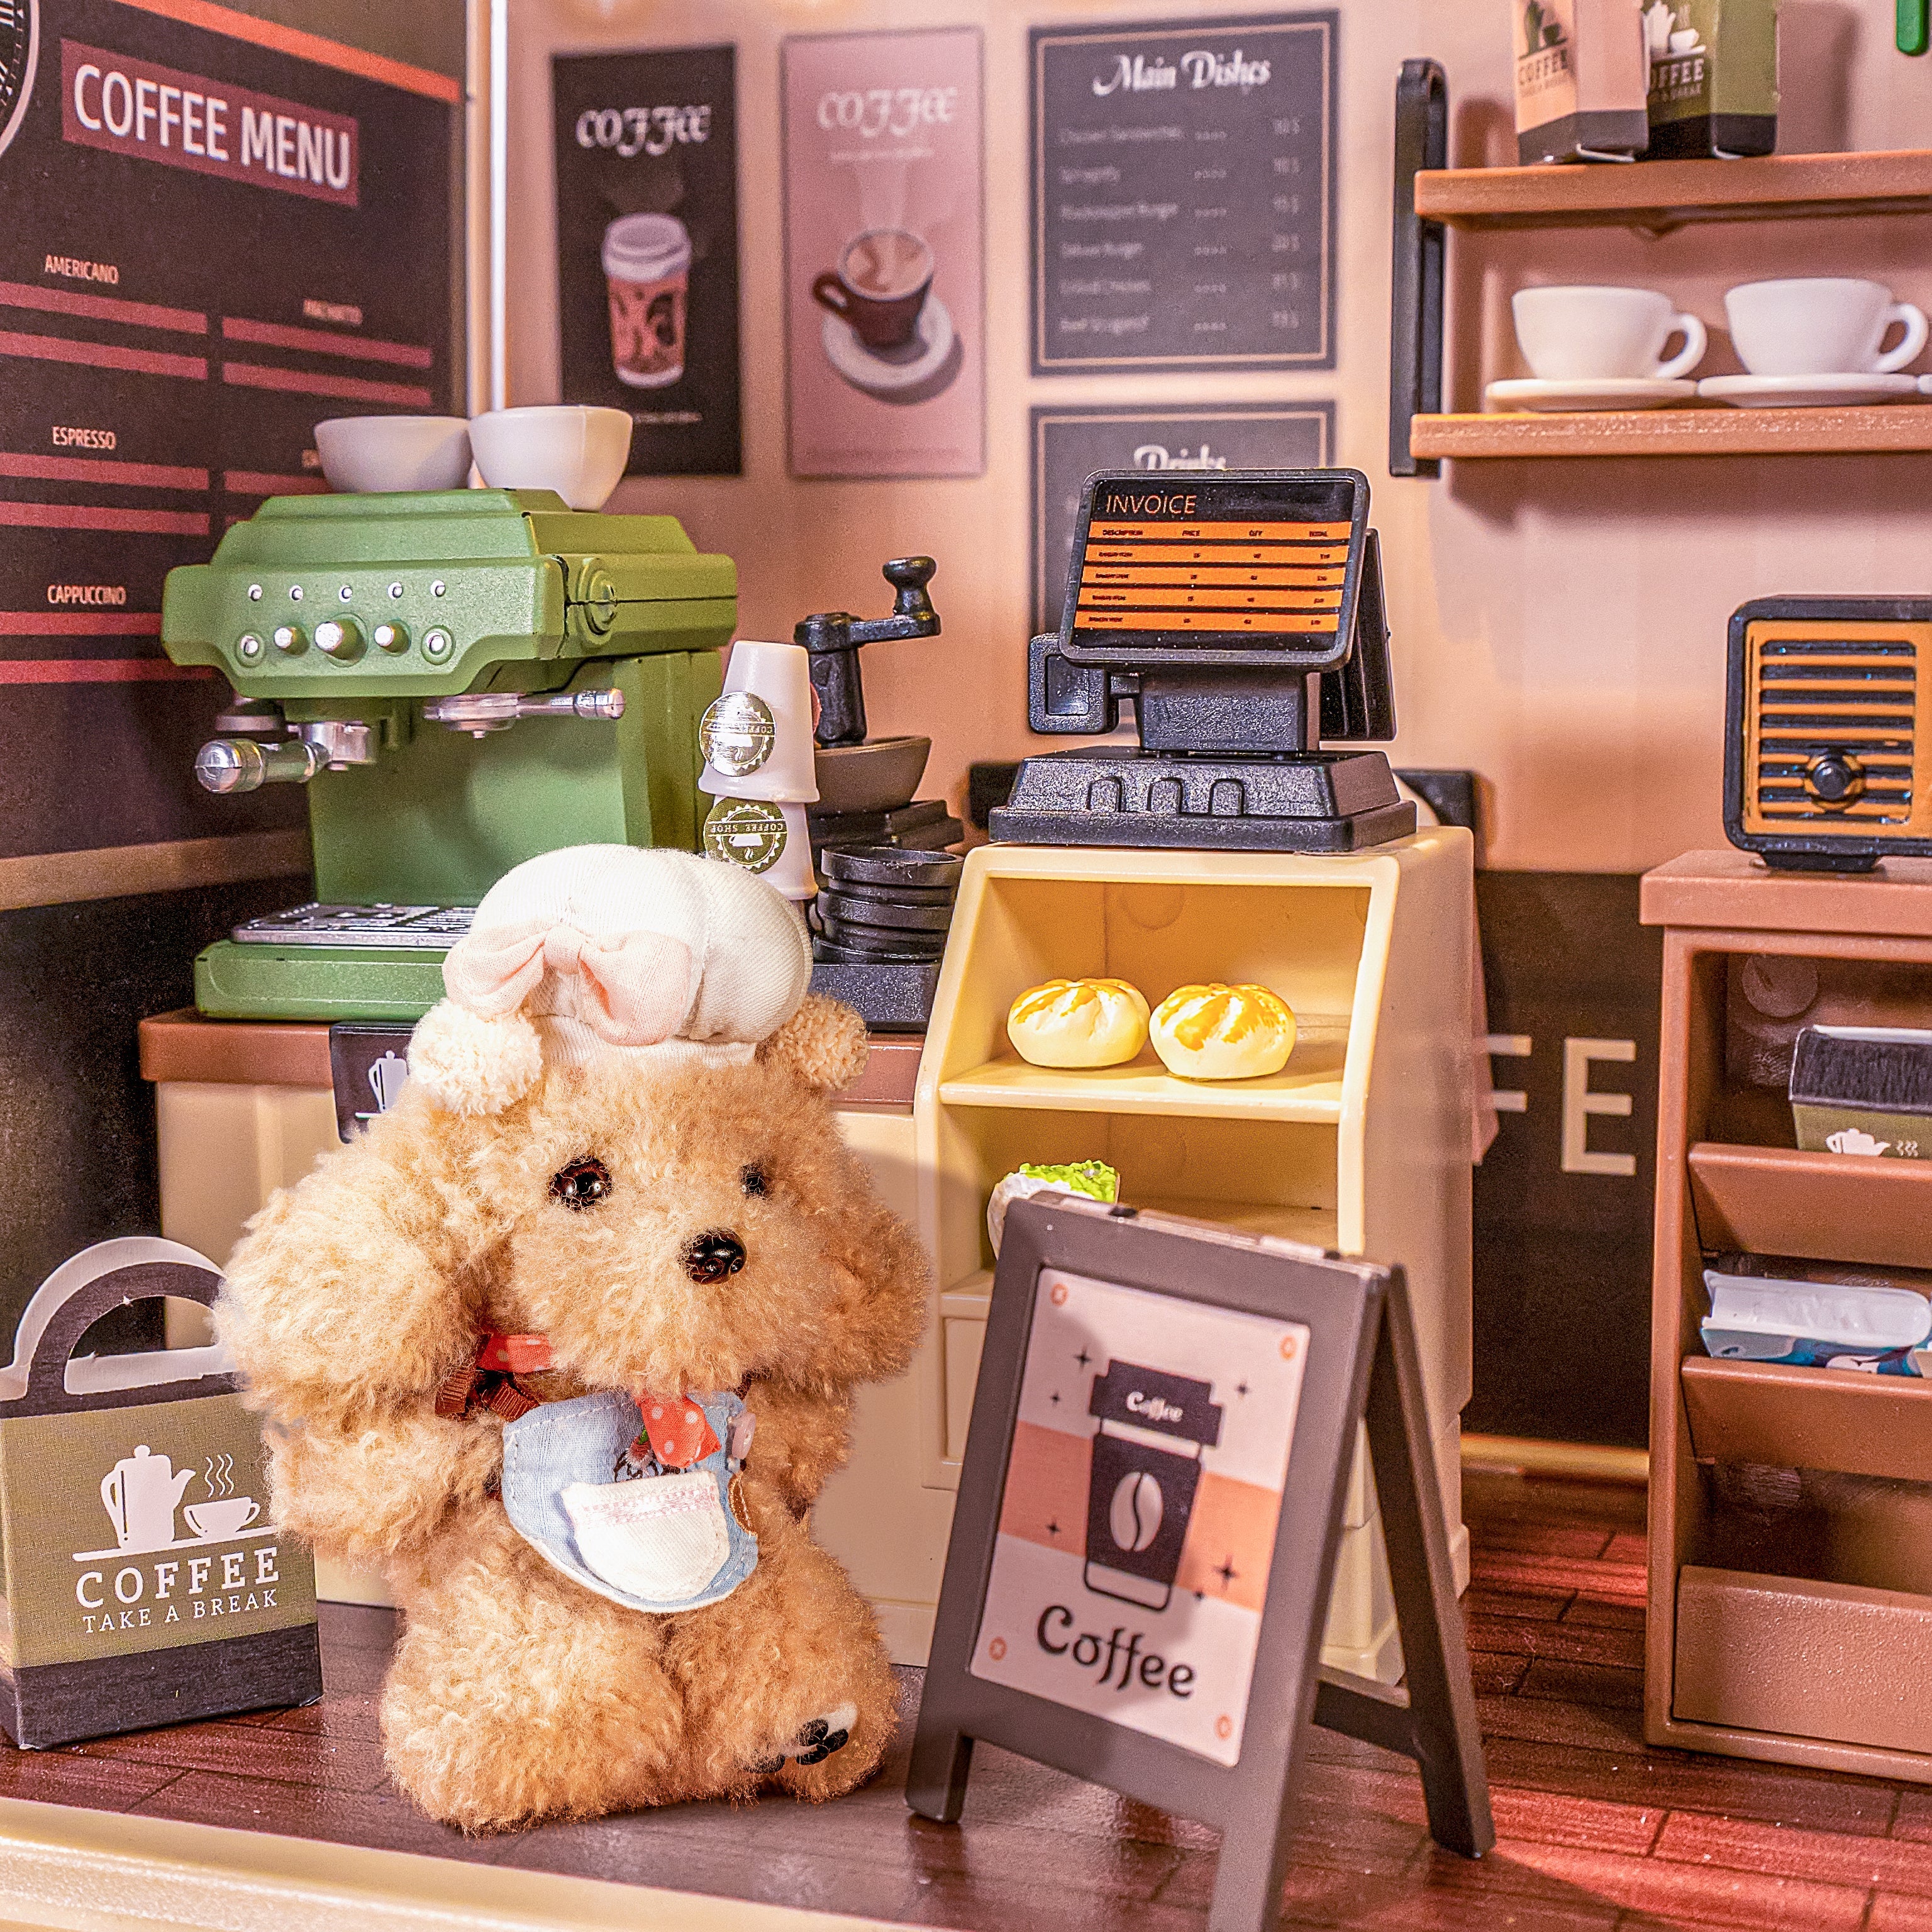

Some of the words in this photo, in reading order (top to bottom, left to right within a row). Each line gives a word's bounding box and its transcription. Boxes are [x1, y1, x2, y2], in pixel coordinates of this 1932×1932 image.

[1092, 54, 1177, 96] Main
[1180, 50, 1272, 95] Dishes
[1648, 58, 1705, 90] OFFEE
[74, 64, 230, 161] COFFEE
[239, 106, 351, 190] MENU
[45, 254, 119, 284] AMERICANO
[52, 426, 116, 450] ESPRESSO
[1105, 494, 1197, 514] INVOICE
[47, 585, 126, 606] CAPPUCCINO
[710, 824, 739, 833] SHOP
[745, 823, 784, 833] COFFEE
[1126, 1391, 1185, 1423] Coffee
[75, 1546, 280, 1609] COFFEE
[82, 1607, 152, 1634] TAKE
[164, 1604, 180, 1624] A
[192, 1588, 278, 1619] BREAK
[1036, 1604, 1195, 1698] Coffee
